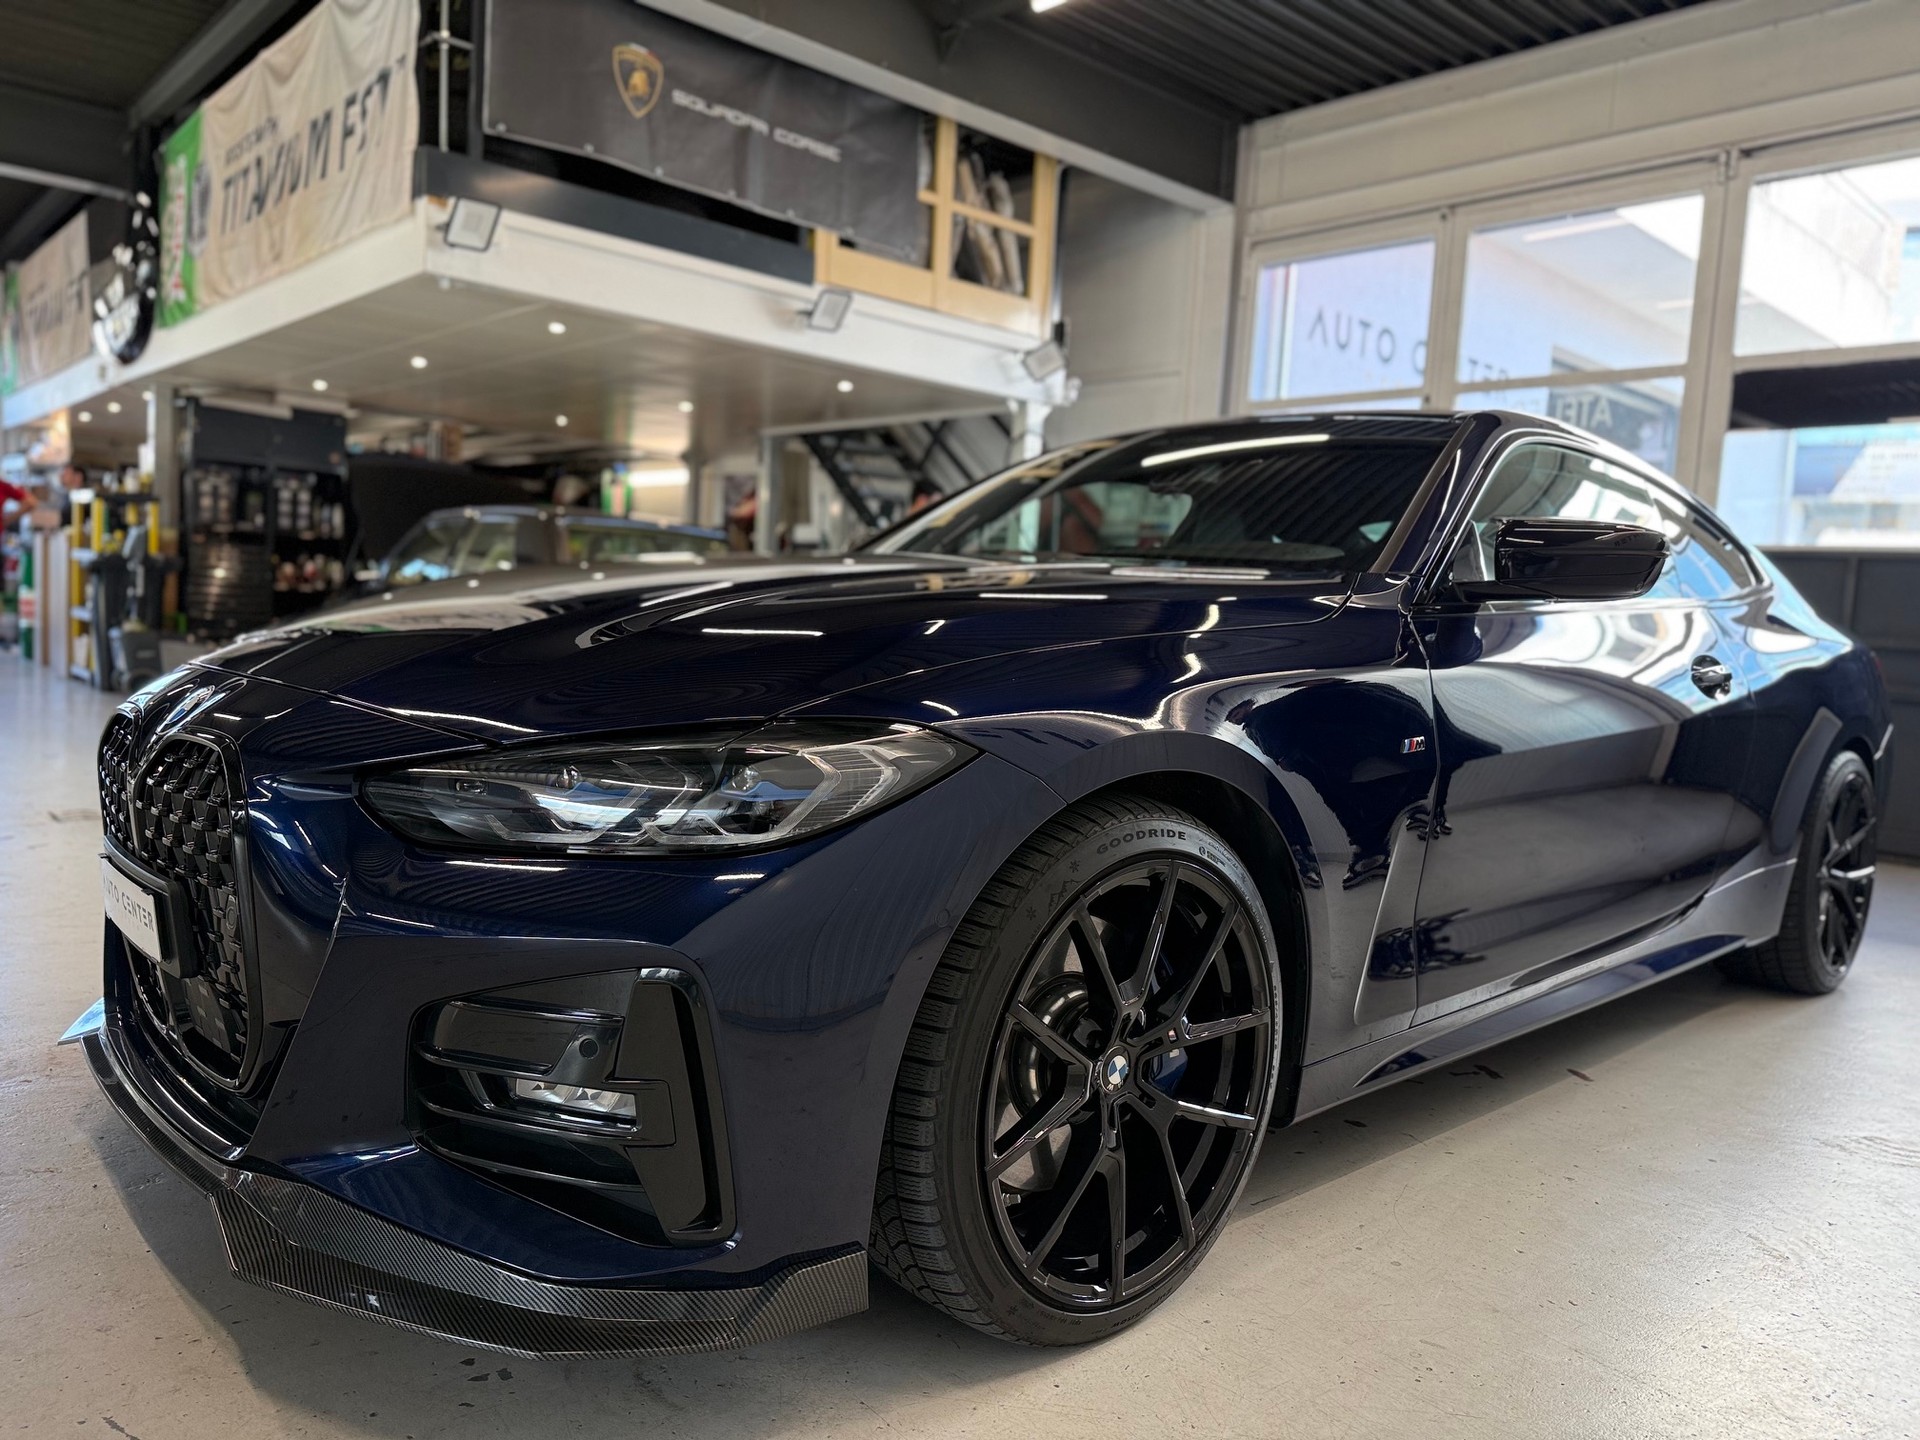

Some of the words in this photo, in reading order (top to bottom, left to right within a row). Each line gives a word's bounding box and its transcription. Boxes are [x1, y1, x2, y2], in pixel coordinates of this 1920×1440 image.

[1308, 307, 1396, 364] AUTO
[1096, 828, 1187, 855] GOODRIDE
[121, 891, 155, 933] CENTER
